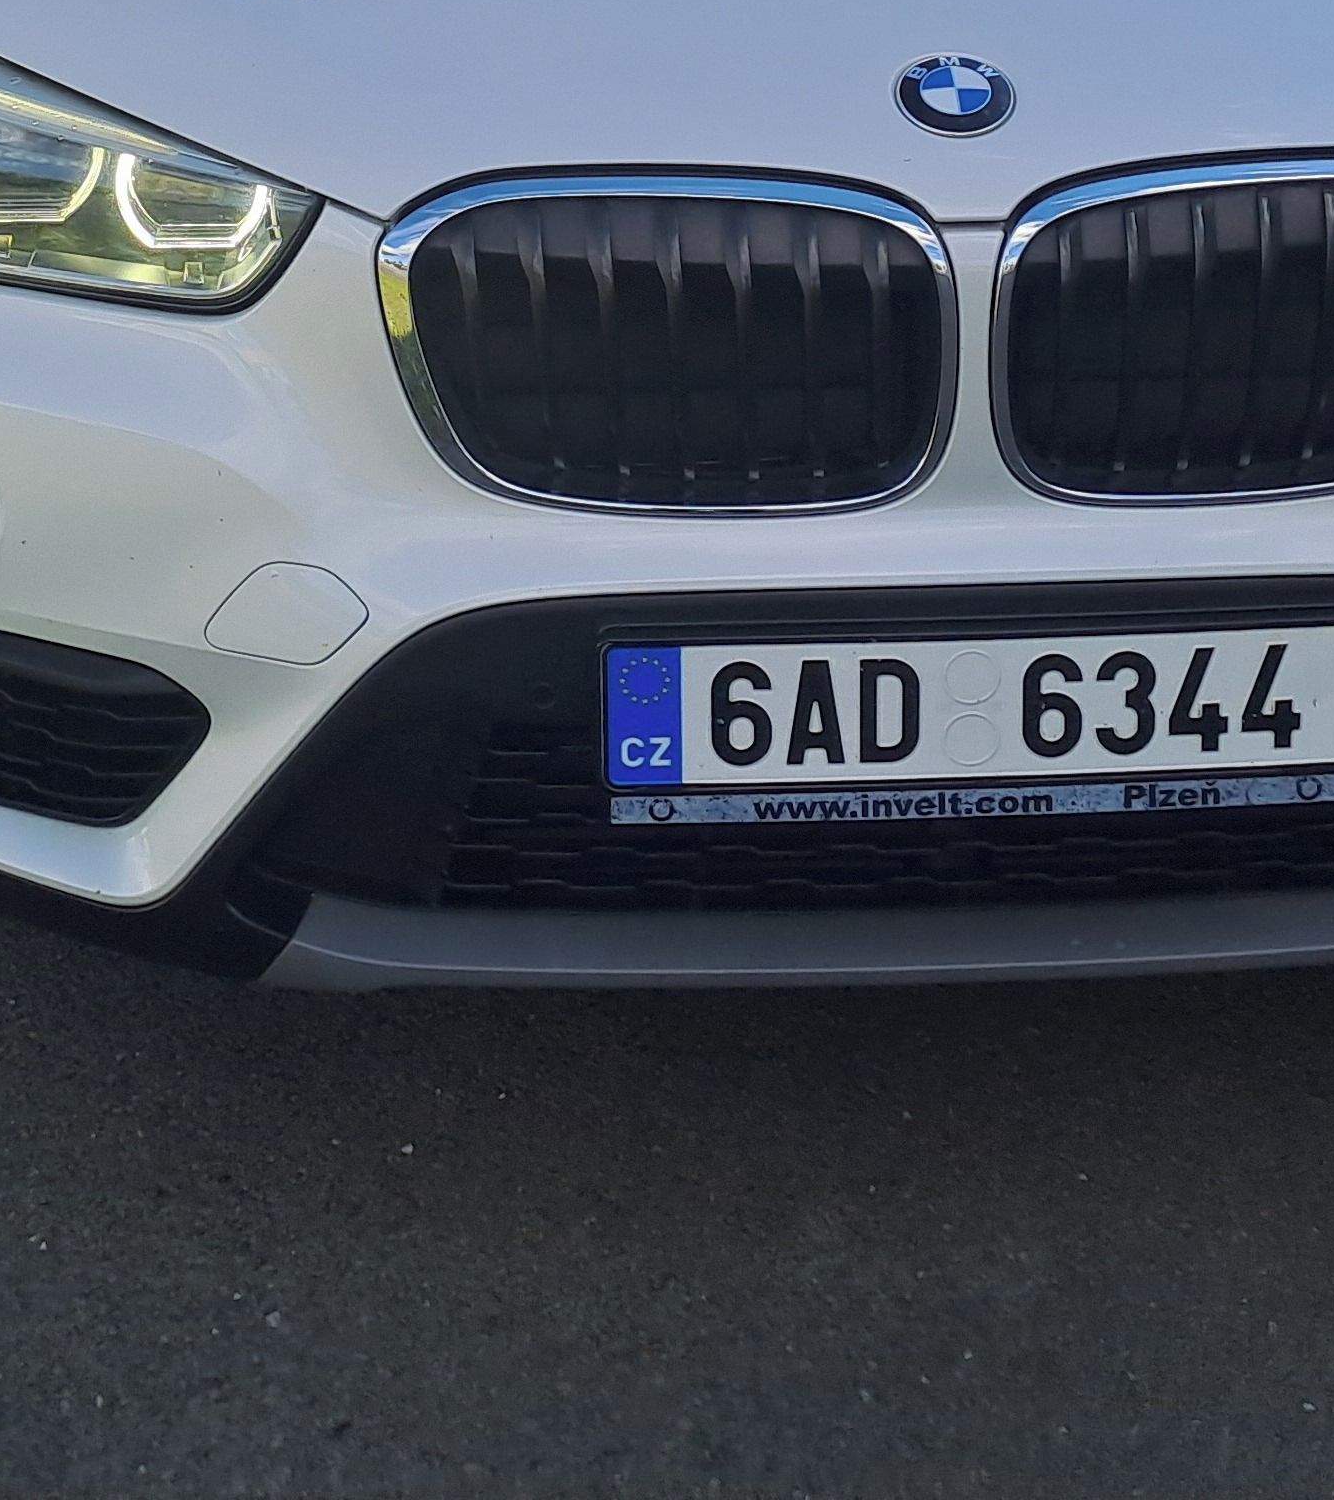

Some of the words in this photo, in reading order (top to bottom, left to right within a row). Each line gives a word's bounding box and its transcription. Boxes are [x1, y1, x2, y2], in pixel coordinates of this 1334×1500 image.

[906, 56, 1000, 80] BMW
[710, 658, 921, 766] 6AD
[1022, 643, 1302, 758] 6344
[620, 736, 672, 767] CZ
[753, 791, 1054, 820] www.invelt.com
[1123, 781, 1221, 809] Plzeň
